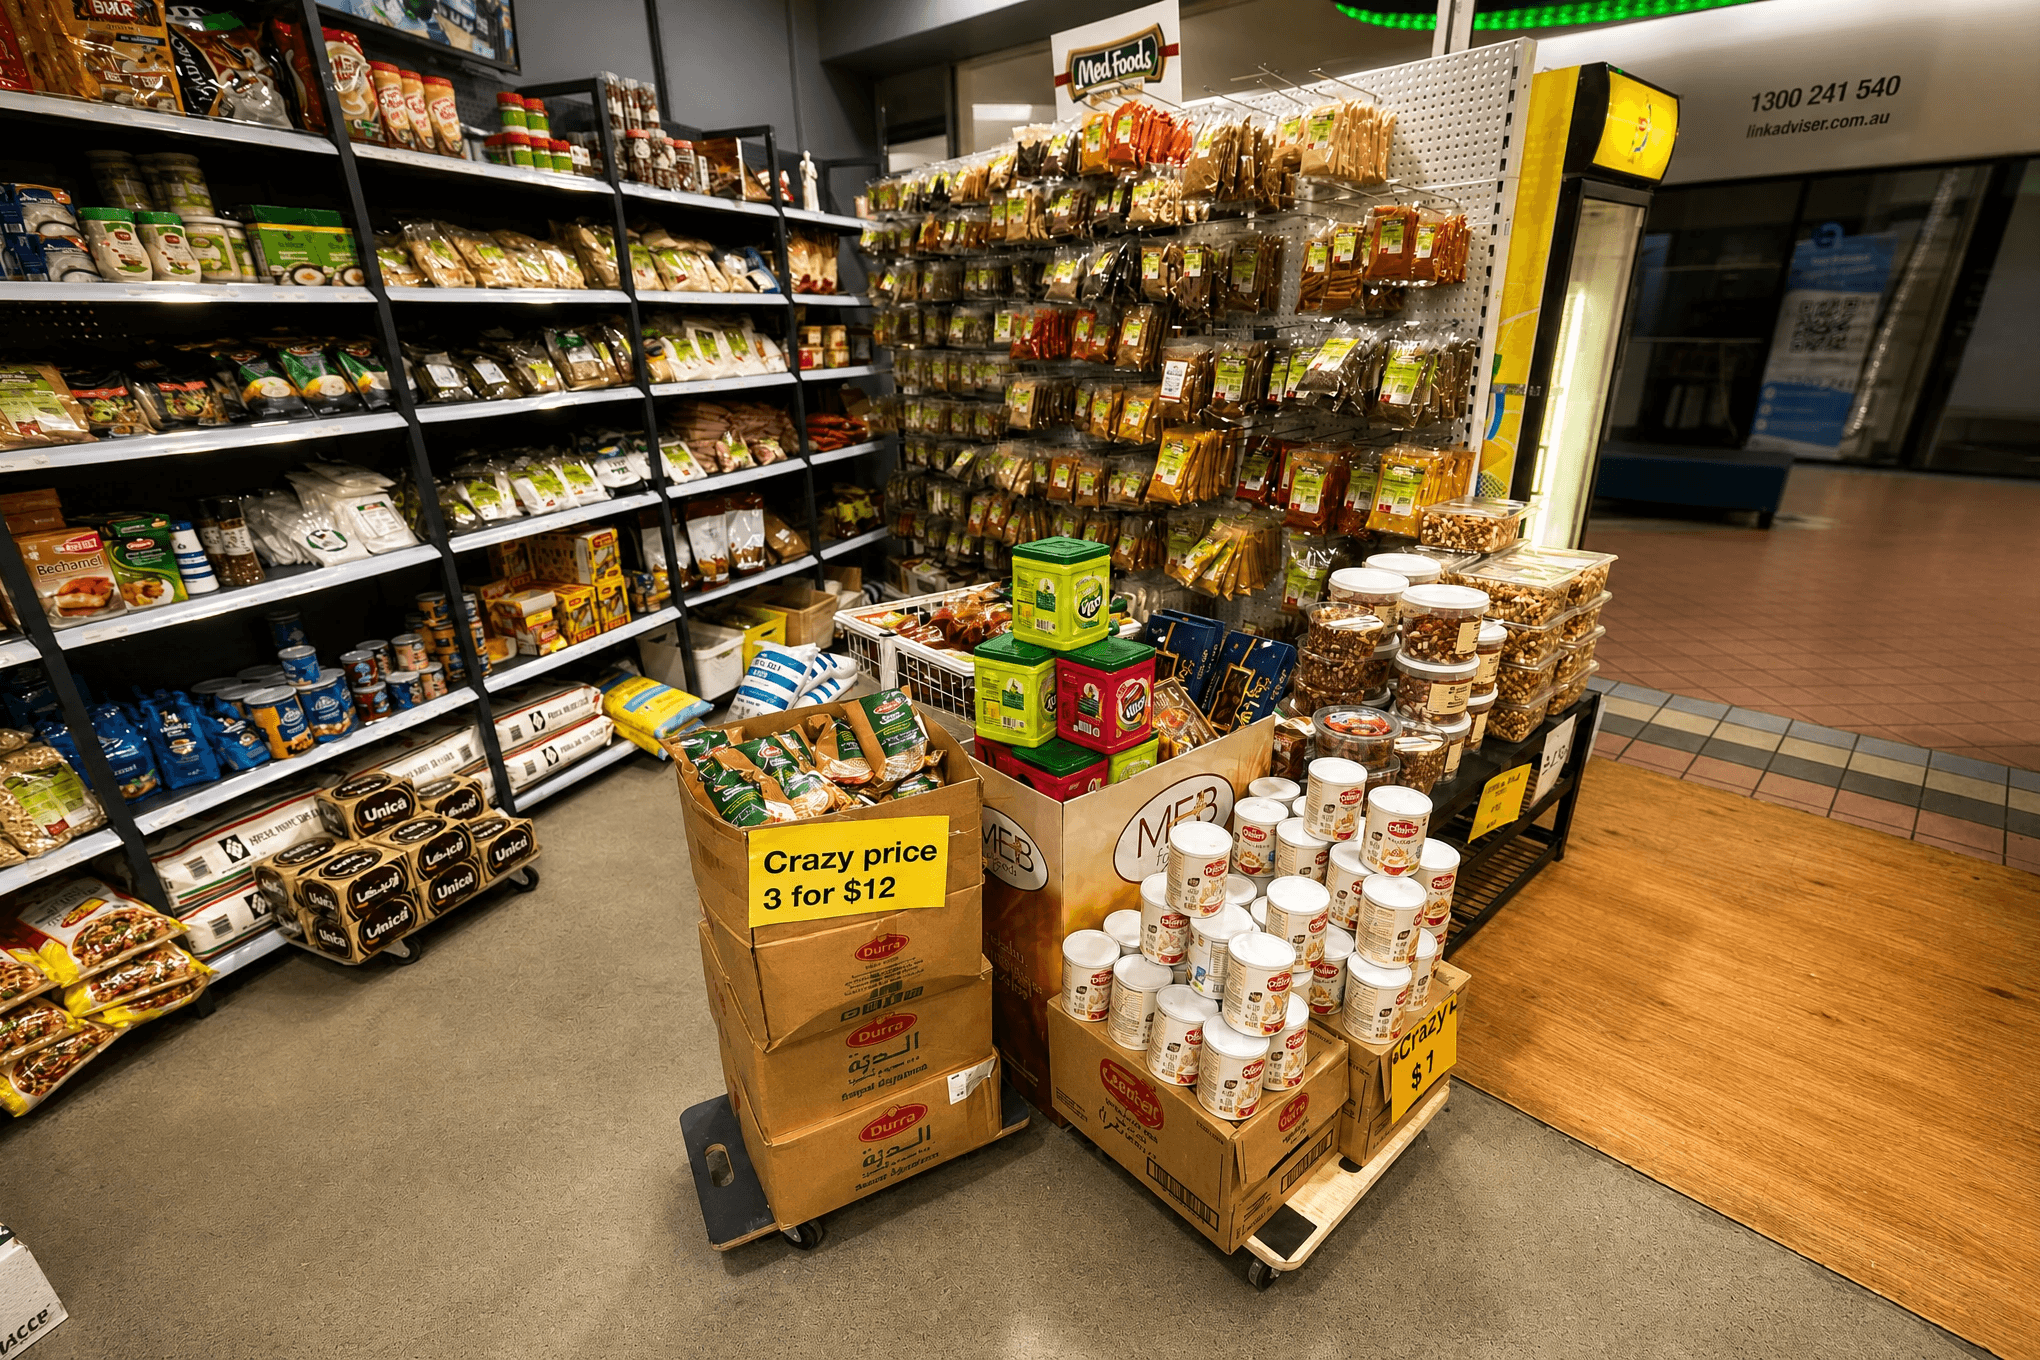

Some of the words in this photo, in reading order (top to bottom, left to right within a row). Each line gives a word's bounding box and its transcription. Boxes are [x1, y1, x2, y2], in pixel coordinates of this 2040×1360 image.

[1075, 51, 1112, 90] Med
[1112, 40, 1152, 79] Foods
[1752, 88, 1803, 112] 1300
[1807, 81, 1848, 106] 241
[1856, 75, 1901, 99] 540
[1746, 113, 1891, 138] linkadviser.com.au
[36, 555, 103, 576] Bechamel
[763, 849, 854, 874] Crazy
[864, 841, 938, 871] price
[763, 888, 782, 910] 3
[791, 885, 836, 908] for
[844, 877, 896, 904] $12
[864, 939, 901, 957] Durra
[858, 1021, 904, 1043] Durra
[1400, 1004, 1448, 1059] Crazy
[1411, 1062, 1422, 1091] $
[1426, 1050, 1434, 1074] 1
[870, 1112, 917, 1137] Durra
